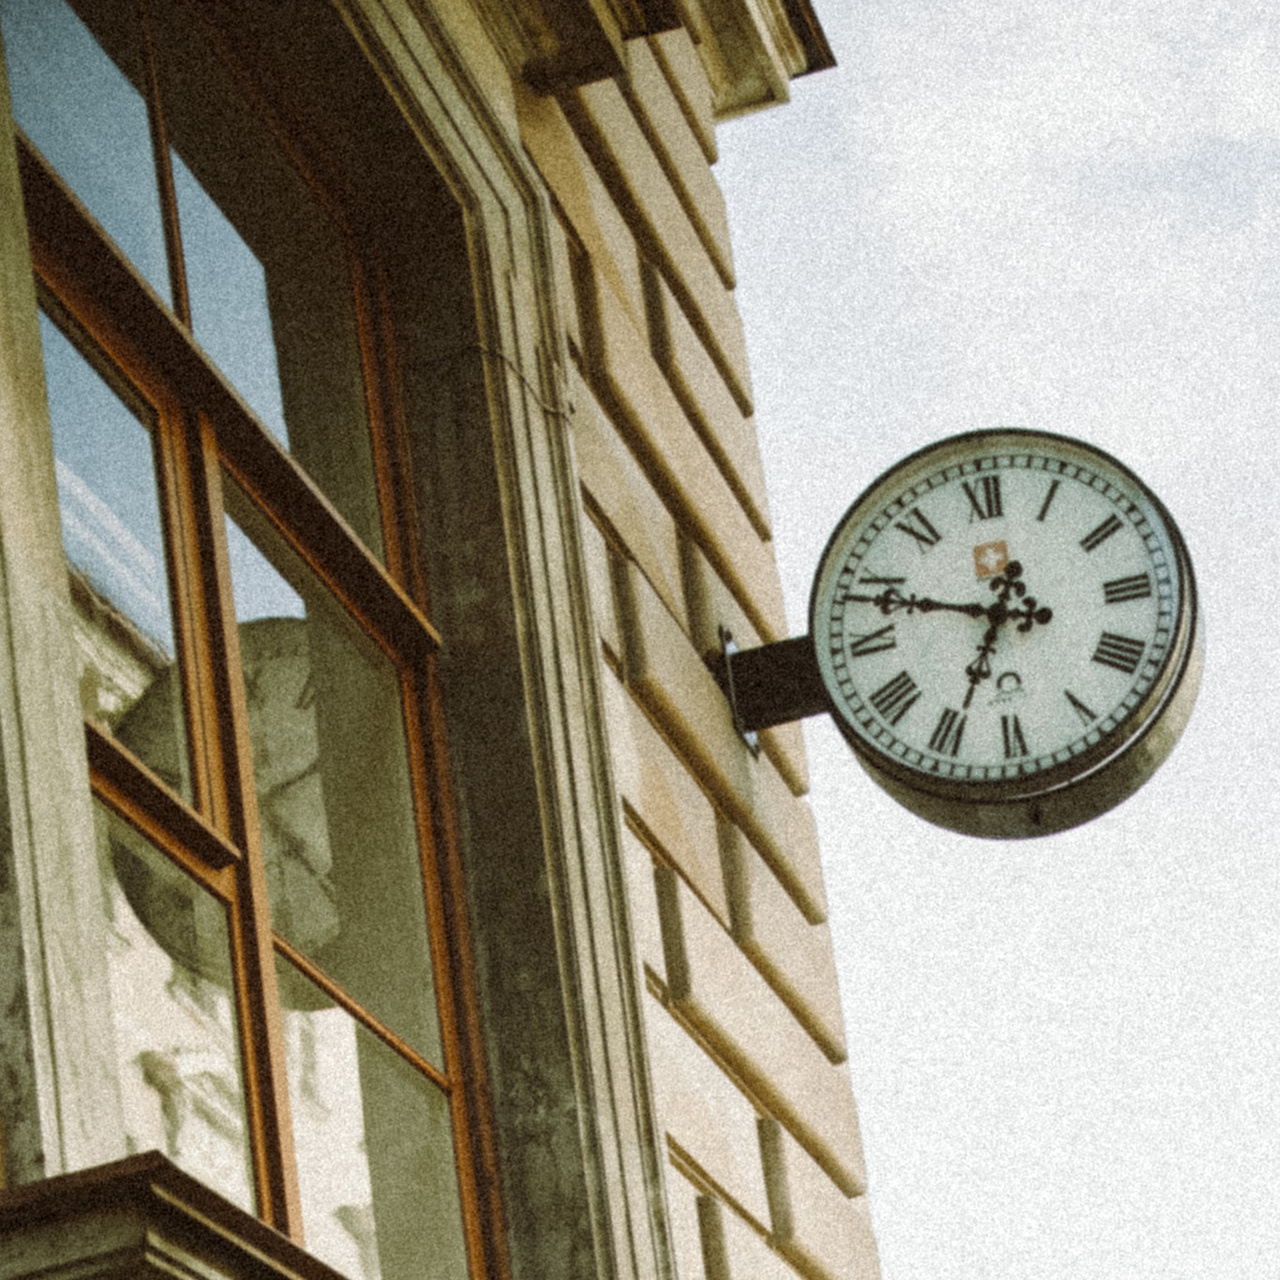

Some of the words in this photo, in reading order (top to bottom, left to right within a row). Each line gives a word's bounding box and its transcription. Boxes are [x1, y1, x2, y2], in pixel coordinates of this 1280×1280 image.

[962, 476, 1003, 523] XII
[1037, 479, 1060, 521] I
[894, 507, 941, 555] XI
[1080, 514, 1123, 552] II
[1103, 572, 1151, 604] III
[849, 623, 896, 657] IX
[1091, 631, 1145, 674] IIII
[869, 670, 922, 726] VIII
[1063, 689, 1097, 726] V
[928, 708, 967, 757] VII
[1002, 714, 1028, 758] VI
